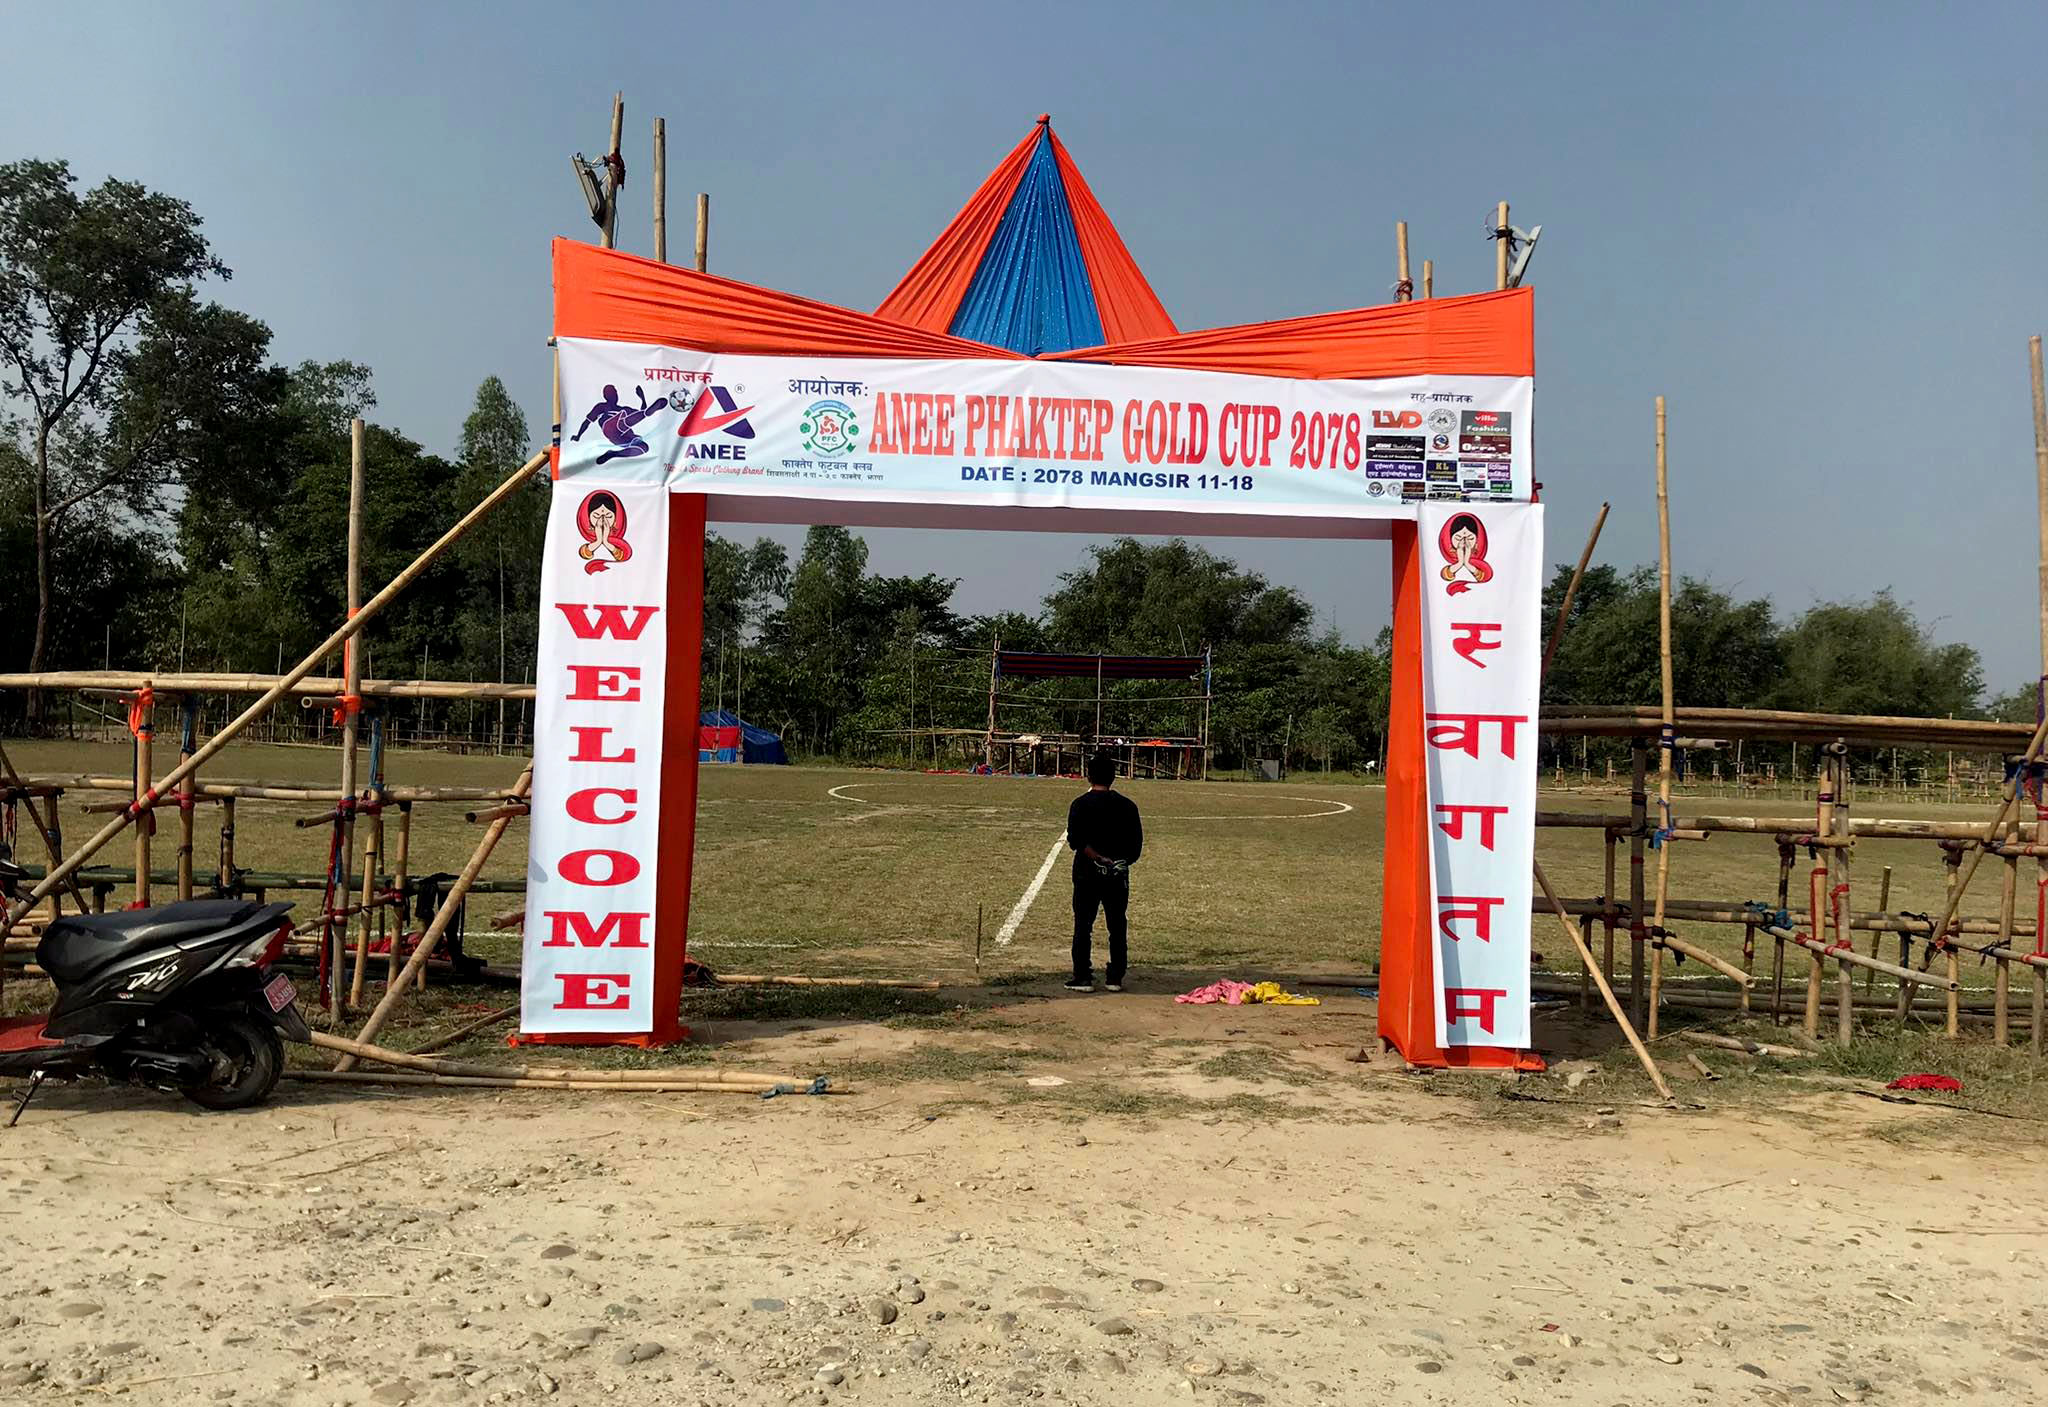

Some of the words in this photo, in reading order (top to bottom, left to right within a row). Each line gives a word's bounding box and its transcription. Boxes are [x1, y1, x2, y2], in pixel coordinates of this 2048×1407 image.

[644, 366, 714, 384] प्रायोजक
[788, 376, 868, 397] आयोजक:
[868, 392, 955, 456] ANEE
[964, 395, 1113, 461] PHAKTEP
[1122, 399, 1209, 465] GOLD
[1218, 402, 1281, 468] CUP
[1290, 411, 1360, 471] 2078
[684, 444, 746, 460] ANEE
[742, 465, 765, 475] Brand
[961, 466, 1014, 481] DATE
[1034, 469, 1083, 484] 2078
[1091, 471, 1190, 488] MANGSIR
[1197, 474, 1253, 491] 11-18
[541, 603, 660, 1011] WELCOME
